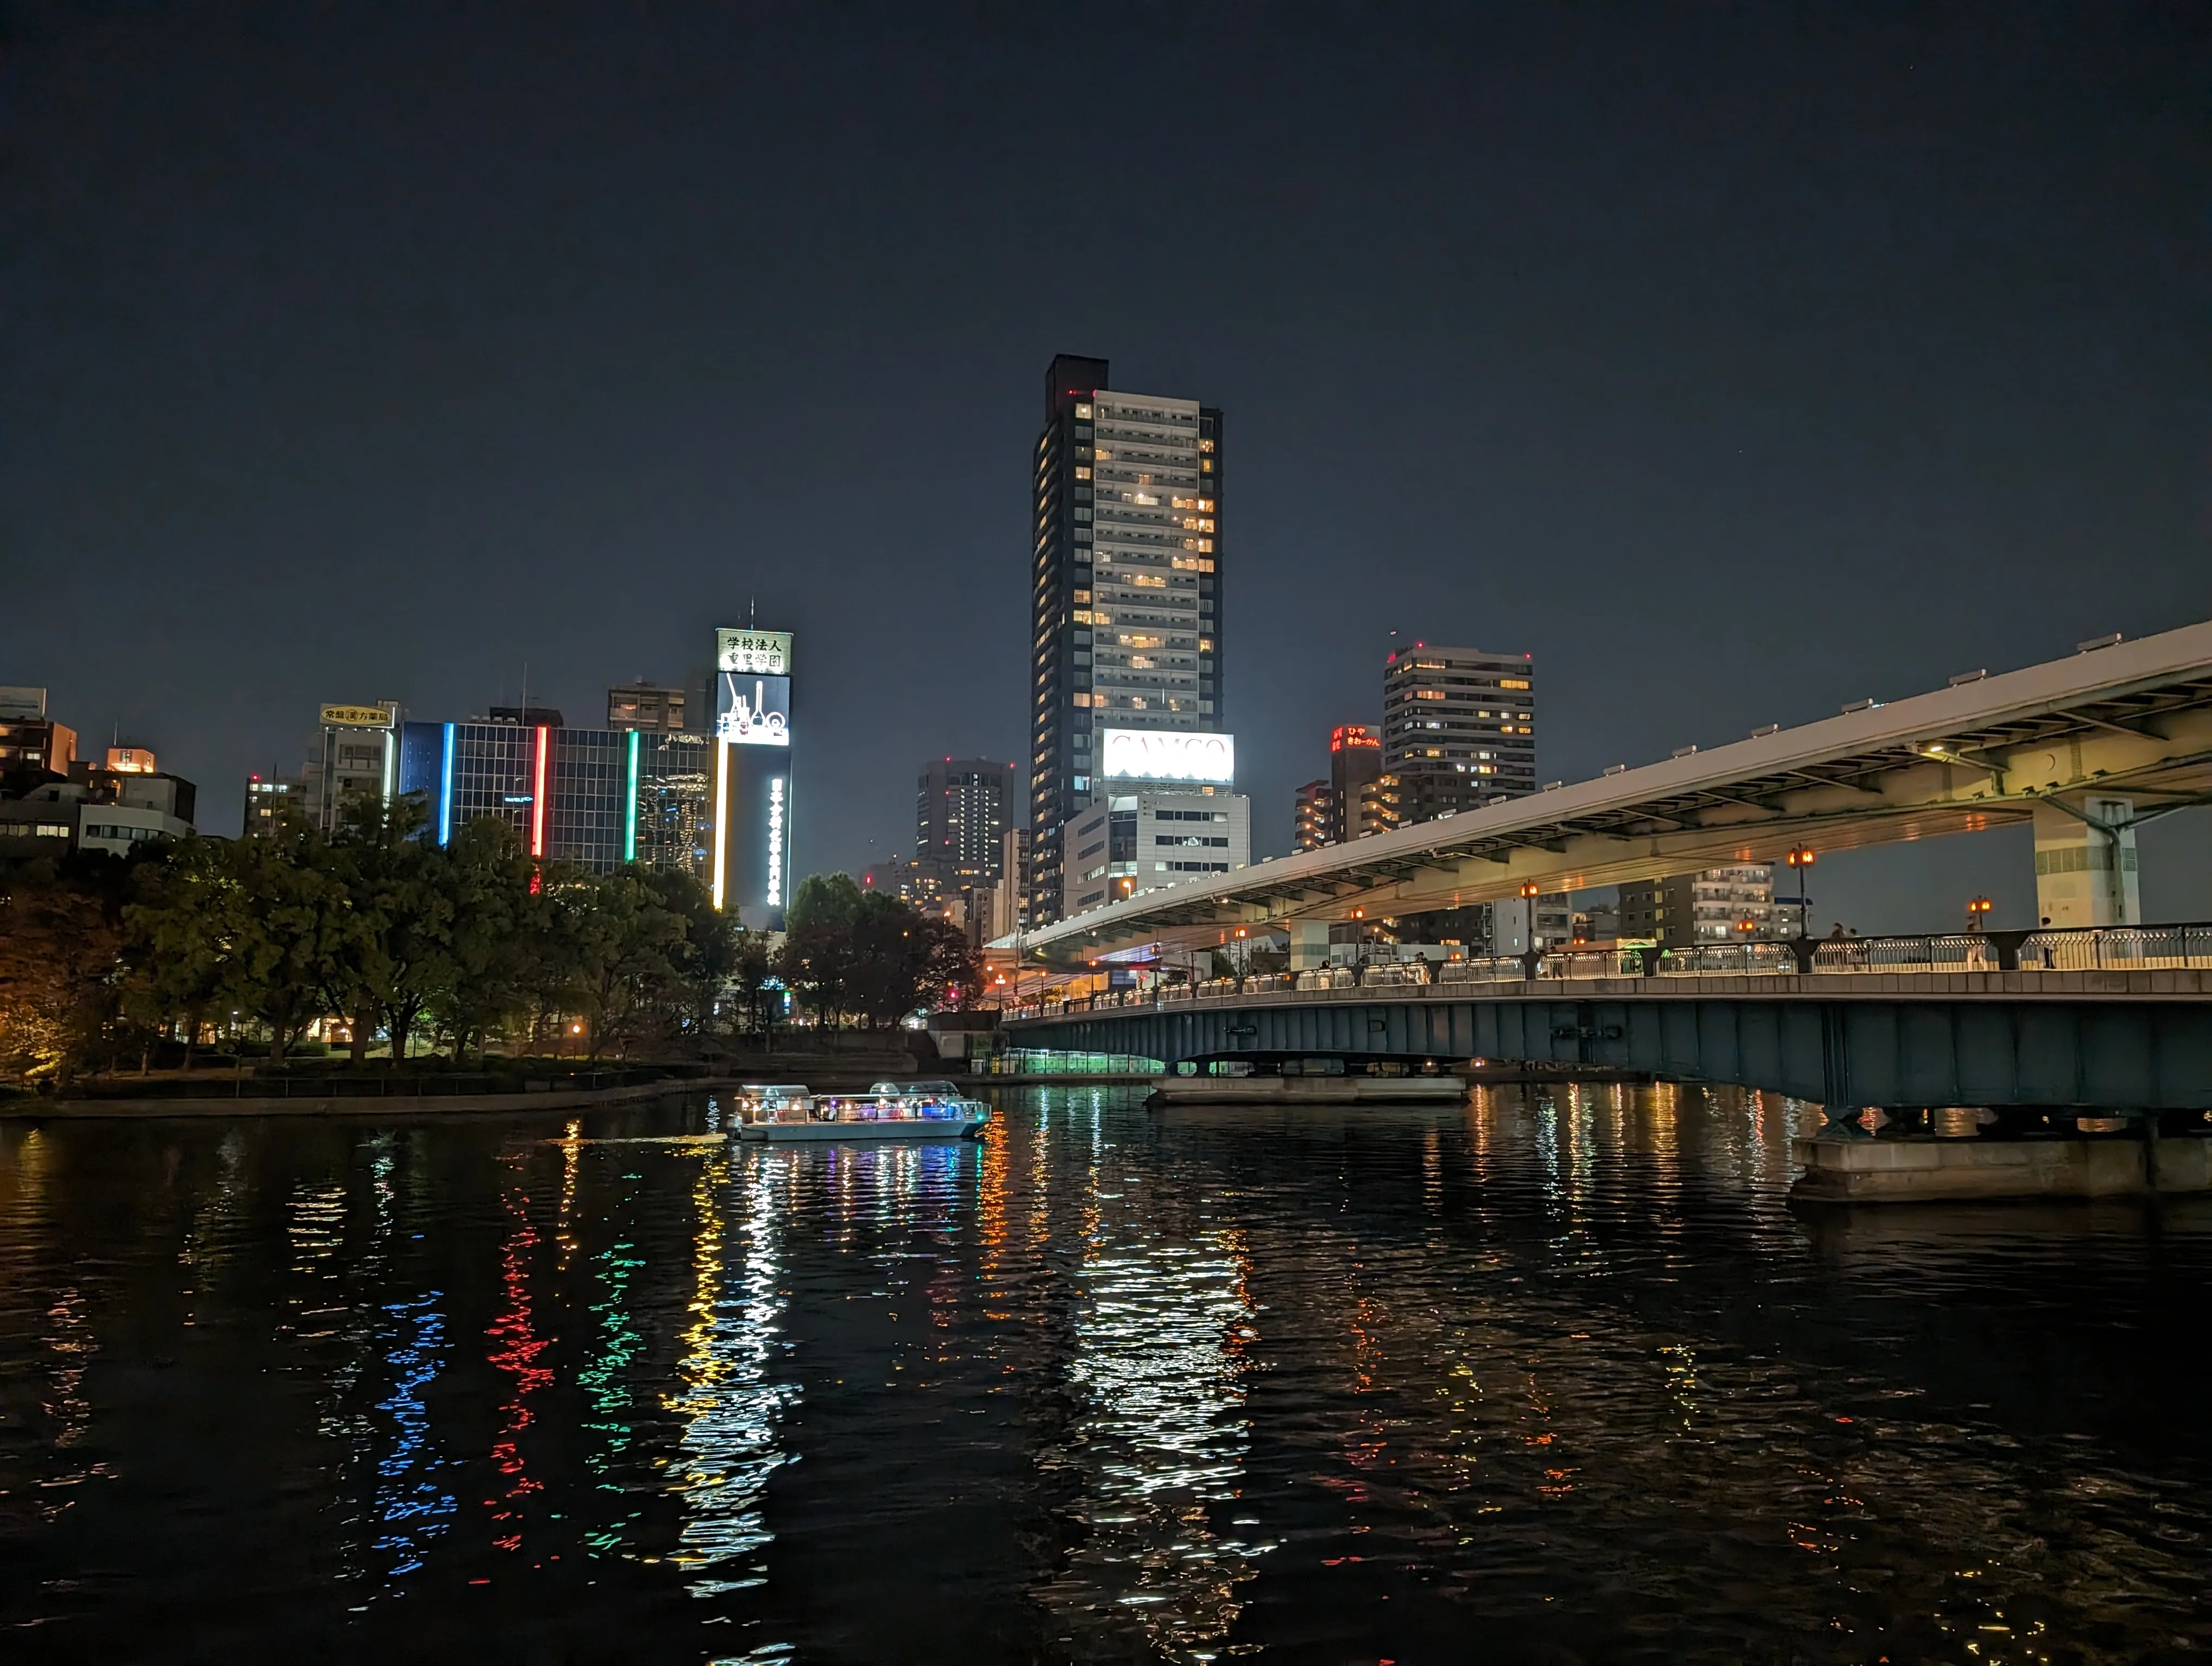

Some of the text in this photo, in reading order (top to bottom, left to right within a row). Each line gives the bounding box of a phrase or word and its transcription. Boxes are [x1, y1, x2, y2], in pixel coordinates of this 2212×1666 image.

[727, 637, 781, 652] 学校法人
[325, 709, 388, 721] 常盤漢方薬局
[1348, 727, 1365, 735] ひや
